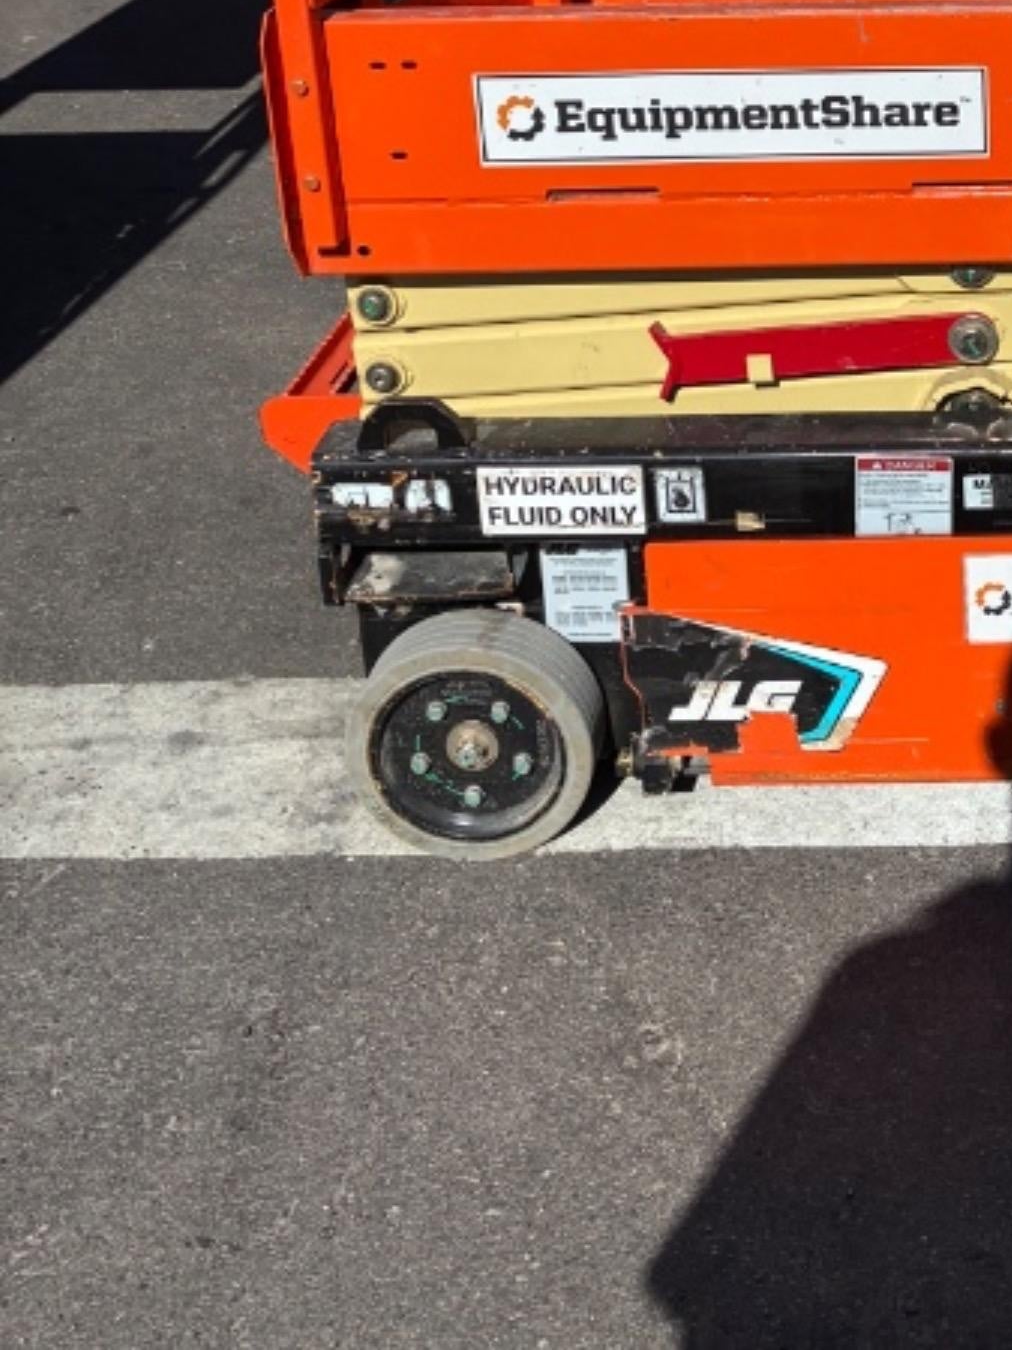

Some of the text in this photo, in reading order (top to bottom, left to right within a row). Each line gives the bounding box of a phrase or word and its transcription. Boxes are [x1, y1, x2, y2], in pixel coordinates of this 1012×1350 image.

[554, 95, 960, 141] EquipmentShare
[484, 475, 637, 497] HYDRAULIC
[488, 505, 638, 526] FLUID ONLY
[667, 680, 803, 722] JLG
